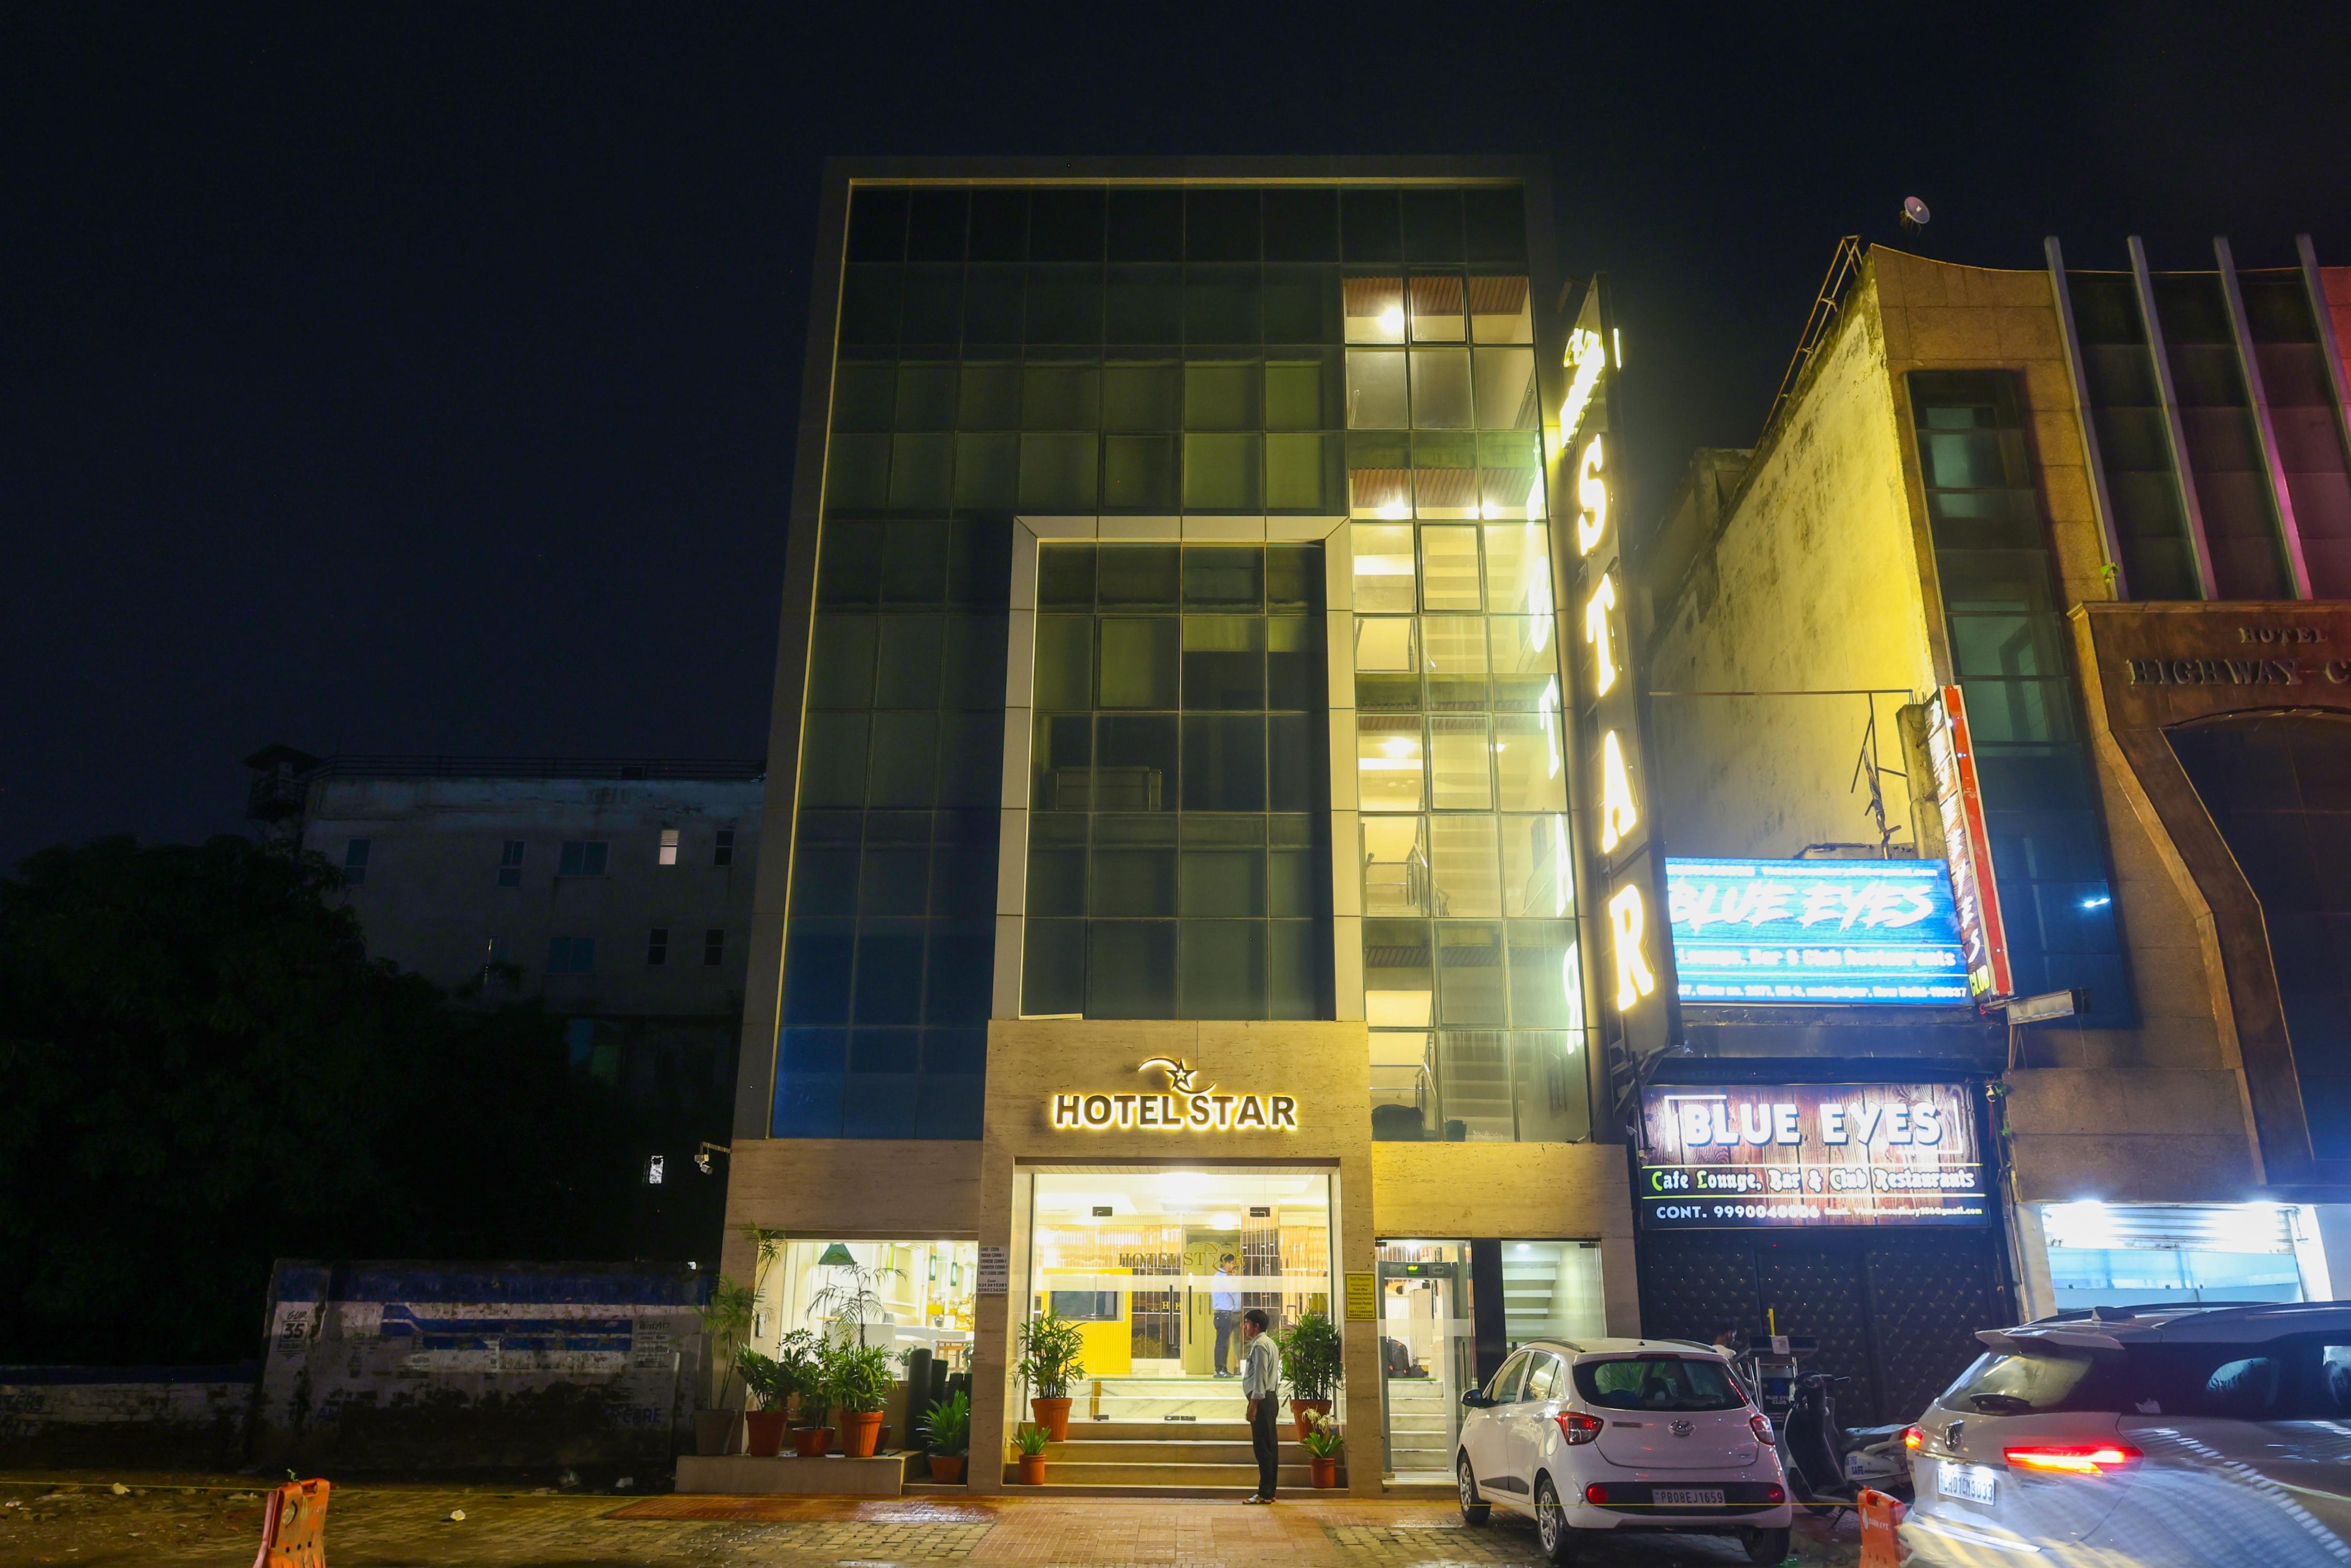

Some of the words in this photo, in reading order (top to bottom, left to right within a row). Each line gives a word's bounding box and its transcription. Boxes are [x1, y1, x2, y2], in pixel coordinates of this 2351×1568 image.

[2239, 627, 2327, 643] HOTEL
[2126, 659, 2303, 685] HIGHWAY
[2325, 659, 2351, 684] C
[1578, 432, 1654, 1012] STAR
[1668, 877, 1797, 936] BLUE
[1795, 880, 1934, 932] EYES
[1968, 964, 1991, 997] CLUB
[1056, 1095, 1181, 1126] HOTEL
[1190, 1095, 1297, 1126] STAR
[1682, 1102, 1802, 1146] BLUE
[1819, 1101, 1943, 1146] EYES
[1651, 1171, 1689, 1191] Cafe
[1696, 1169, 1763, 1192] Lounge,
[1767, 1168, 1802, 1192] Bar
[1808, 1169, 1823, 1192] &
[1829, 1168, 1868, 1191] Club
[1656, 1205, 1707, 1219] CONT.
[1119, 1253, 1178, 1266] HOTEL
[283, 1323, 305, 1339] 35
[1660, 1492, 1723, 1504] PB08EJ1659
